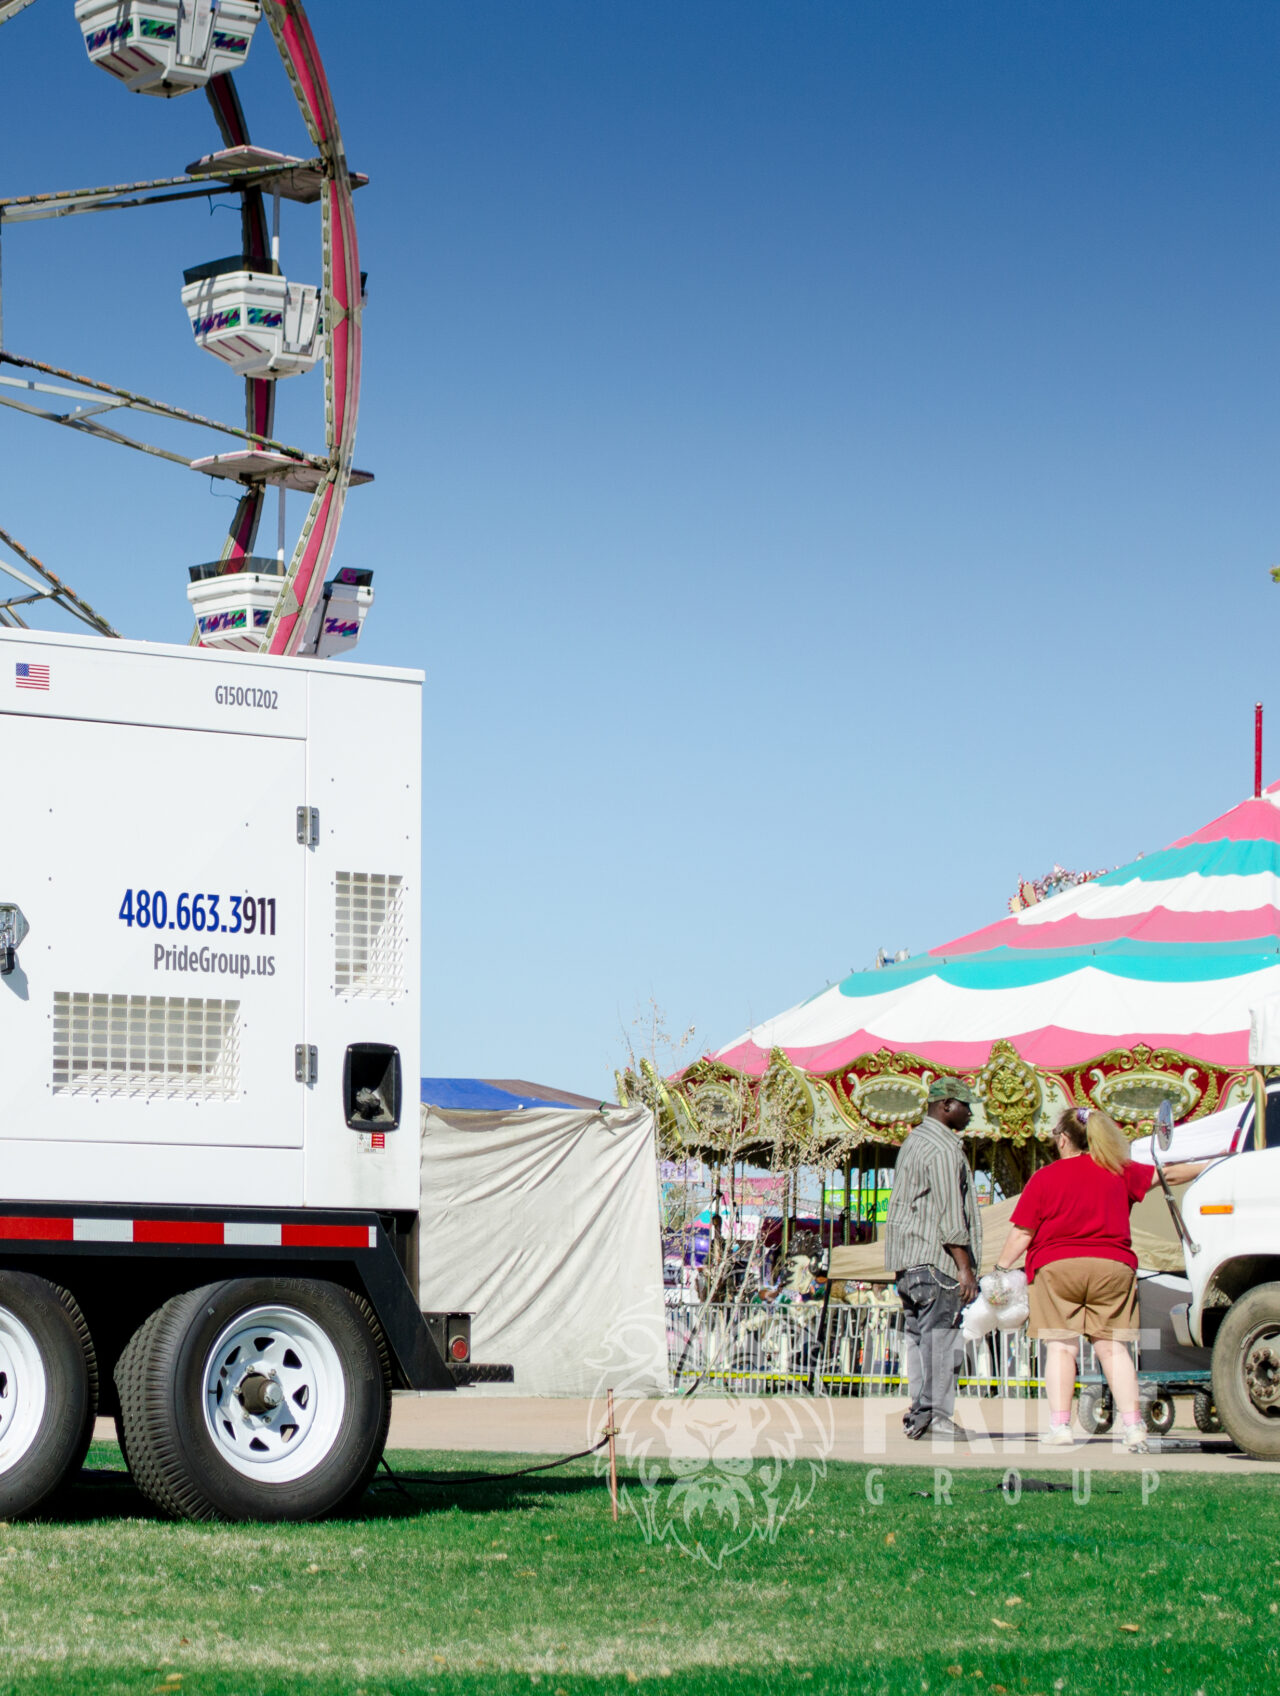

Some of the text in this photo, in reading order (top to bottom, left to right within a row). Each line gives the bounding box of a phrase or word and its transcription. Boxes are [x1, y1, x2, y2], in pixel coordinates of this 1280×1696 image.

[215, 685, 278, 710] G150C1202
[118, 888, 277, 936] 480.663.3911
[153, 943, 276, 979] PrideGroup.us
